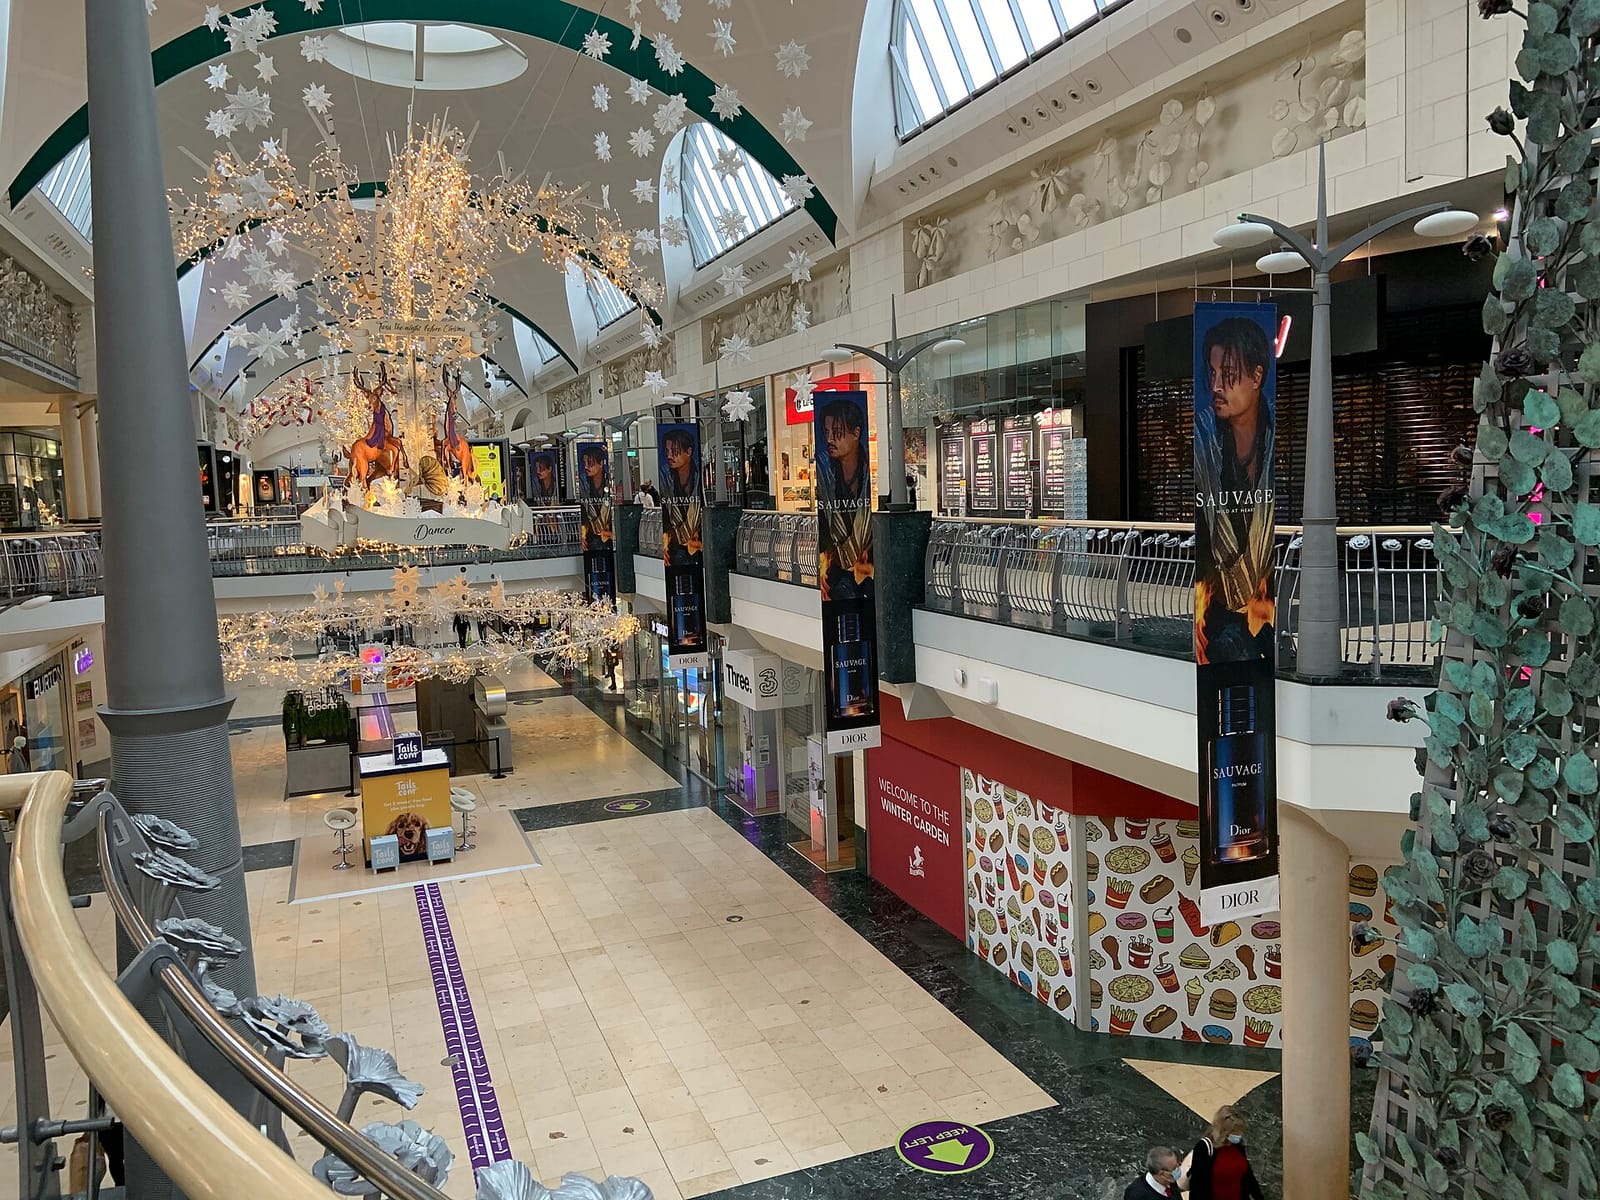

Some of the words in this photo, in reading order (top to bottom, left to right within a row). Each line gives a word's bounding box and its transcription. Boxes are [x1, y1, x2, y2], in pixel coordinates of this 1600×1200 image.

[661, 496, 701, 504] SAUVAGE
[818, 498, 871, 510] SAUVAGE
[1195, 489, 1274, 508] SAUVAGE
[413, 523, 456, 541] Dancer
[679, 655, 699, 665] DIOR
[835, 658, 867, 669] SAUVAGE
[33, 664, 63, 699] BURTON
[725, 663, 753, 694] Three.
[841, 733, 868, 745] DIOR
[395, 740, 418, 754] Tails
[1213, 762, 1263, 780] SAUVAGE
[395, 778, 417, 791] Tails
[879, 776, 919, 809] WELCOME
[920, 797, 932, 815] TO
[932, 804, 950, 826] THE
[880, 796, 912, 825] WINTER
[913, 815, 950, 847] GARDEN
[1230, 824, 1252, 837] Dior
[431, 838, 450, 851] Tails
[374, 847, 395, 860] Tails
[1221, 889, 1260, 910] DIOR
[936, 1127, 968, 1140] KEEP
[904, 1135, 934, 1149] LEFT
